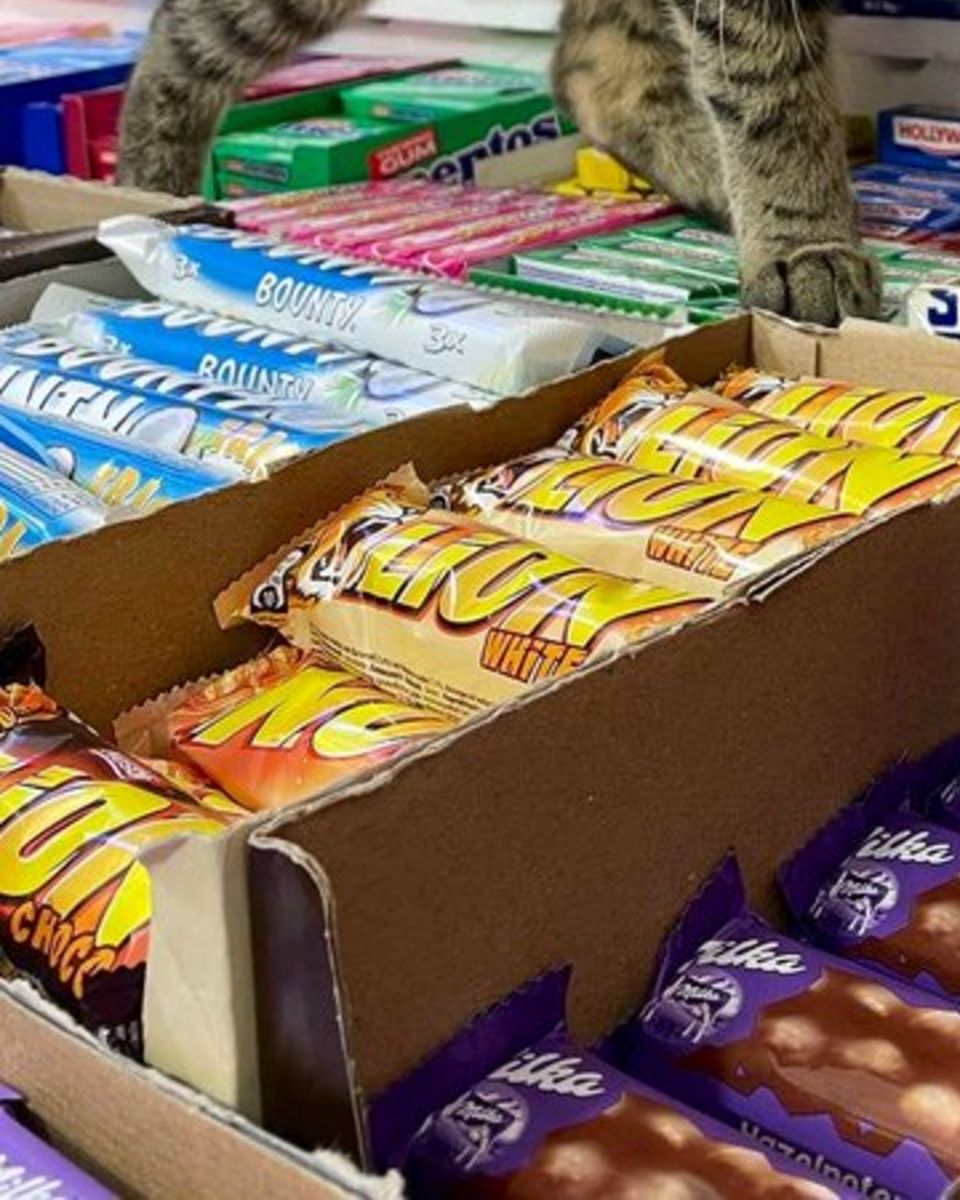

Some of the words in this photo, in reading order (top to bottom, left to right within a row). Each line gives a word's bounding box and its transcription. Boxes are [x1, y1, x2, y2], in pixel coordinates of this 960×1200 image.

[380, 139, 437, 174] GUM
[254, 271, 367, 332] BOUNTY
[424, 324, 469, 357] 3x
[199, 352, 316, 402] BOUNTY
[520, 454, 868, 545] LION
[350, 521, 708, 650] LION
[480, 626, 590, 683] WHITE
[855, 826, 955, 865] ilka
[488, 1048, 604, 1098] ilka
[737, 1117, 900, 1200] Hazelnote
